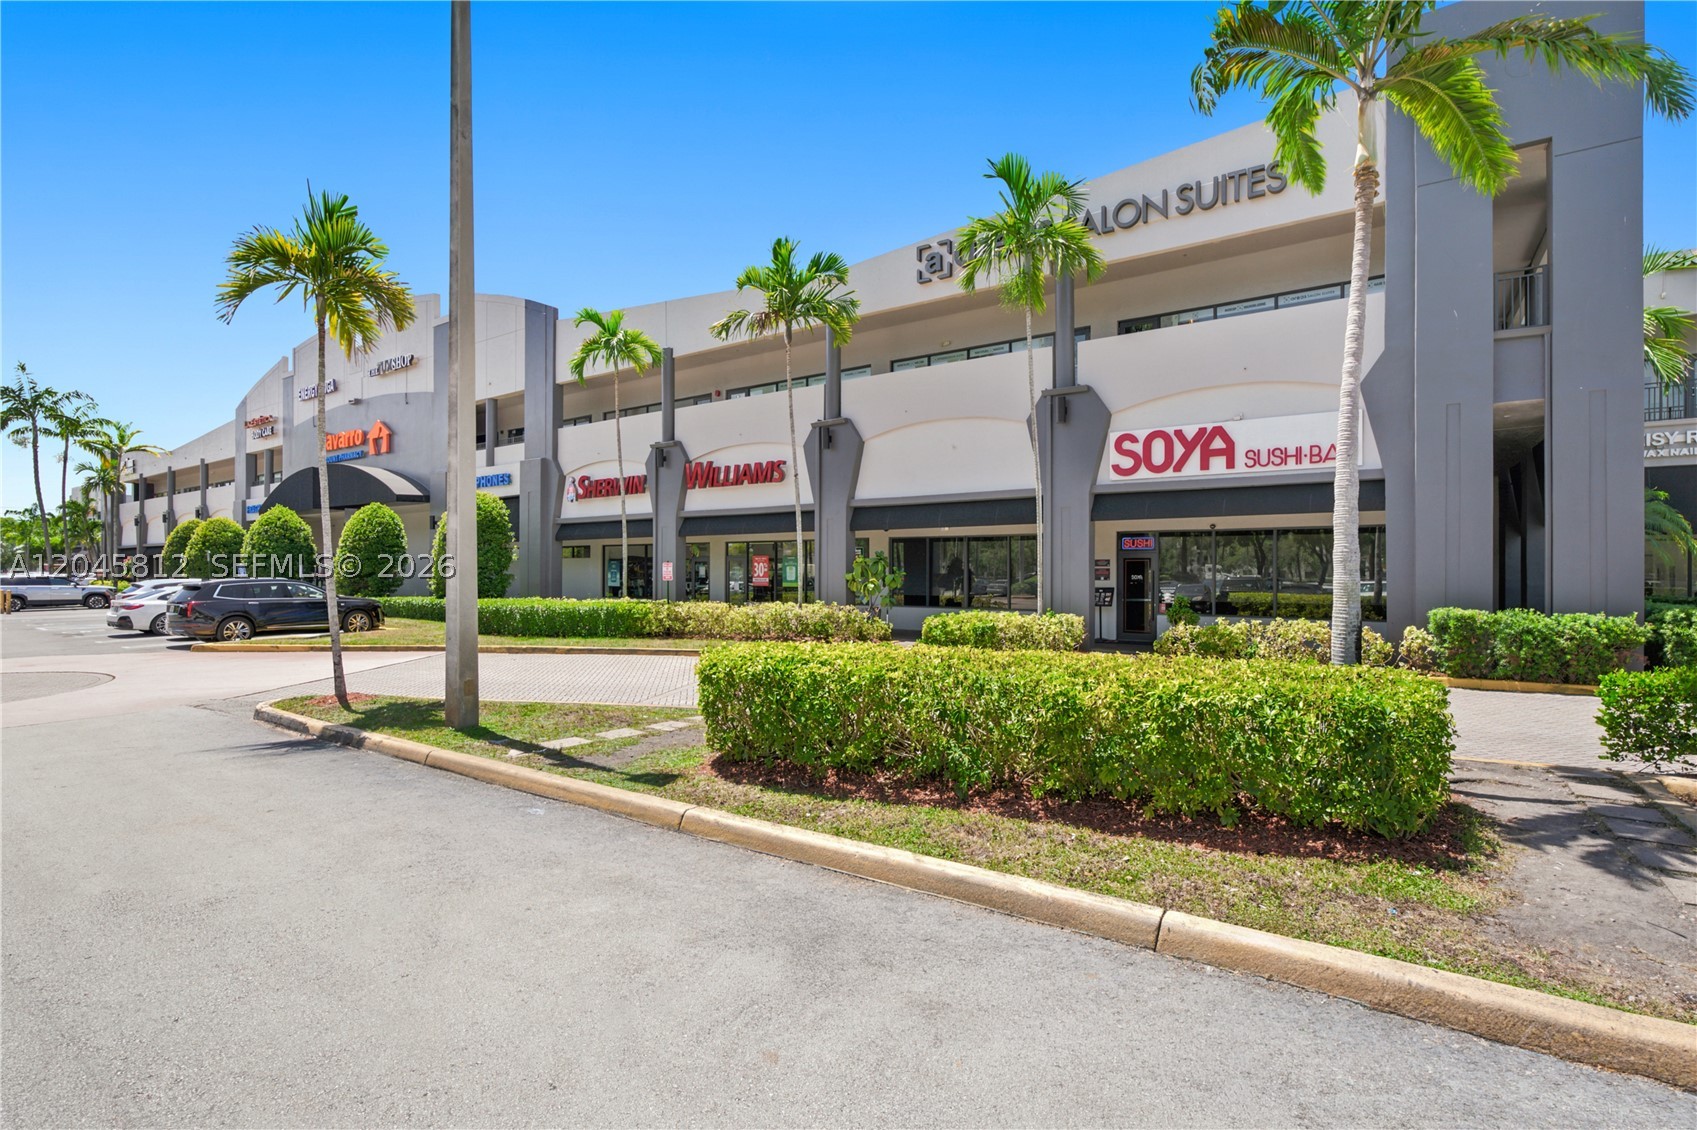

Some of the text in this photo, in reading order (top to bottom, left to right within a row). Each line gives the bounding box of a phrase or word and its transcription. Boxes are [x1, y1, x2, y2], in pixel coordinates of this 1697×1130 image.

[1067, 189, 1169, 236] ALON
[1175, 159, 1288, 216] SUITES
[391, 355, 415, 371] SHOP
[326, 429, 365, 451] avarro
[1644, 431, 1679, 447] ISY
[1111, 425, 1236, 477] SOYA
[476, 473, 513, 488] PHONES
[577, 460, 787, 499] SHERWIN WILLIAMS
[1124, 539, 1152, 548] SUSHI
